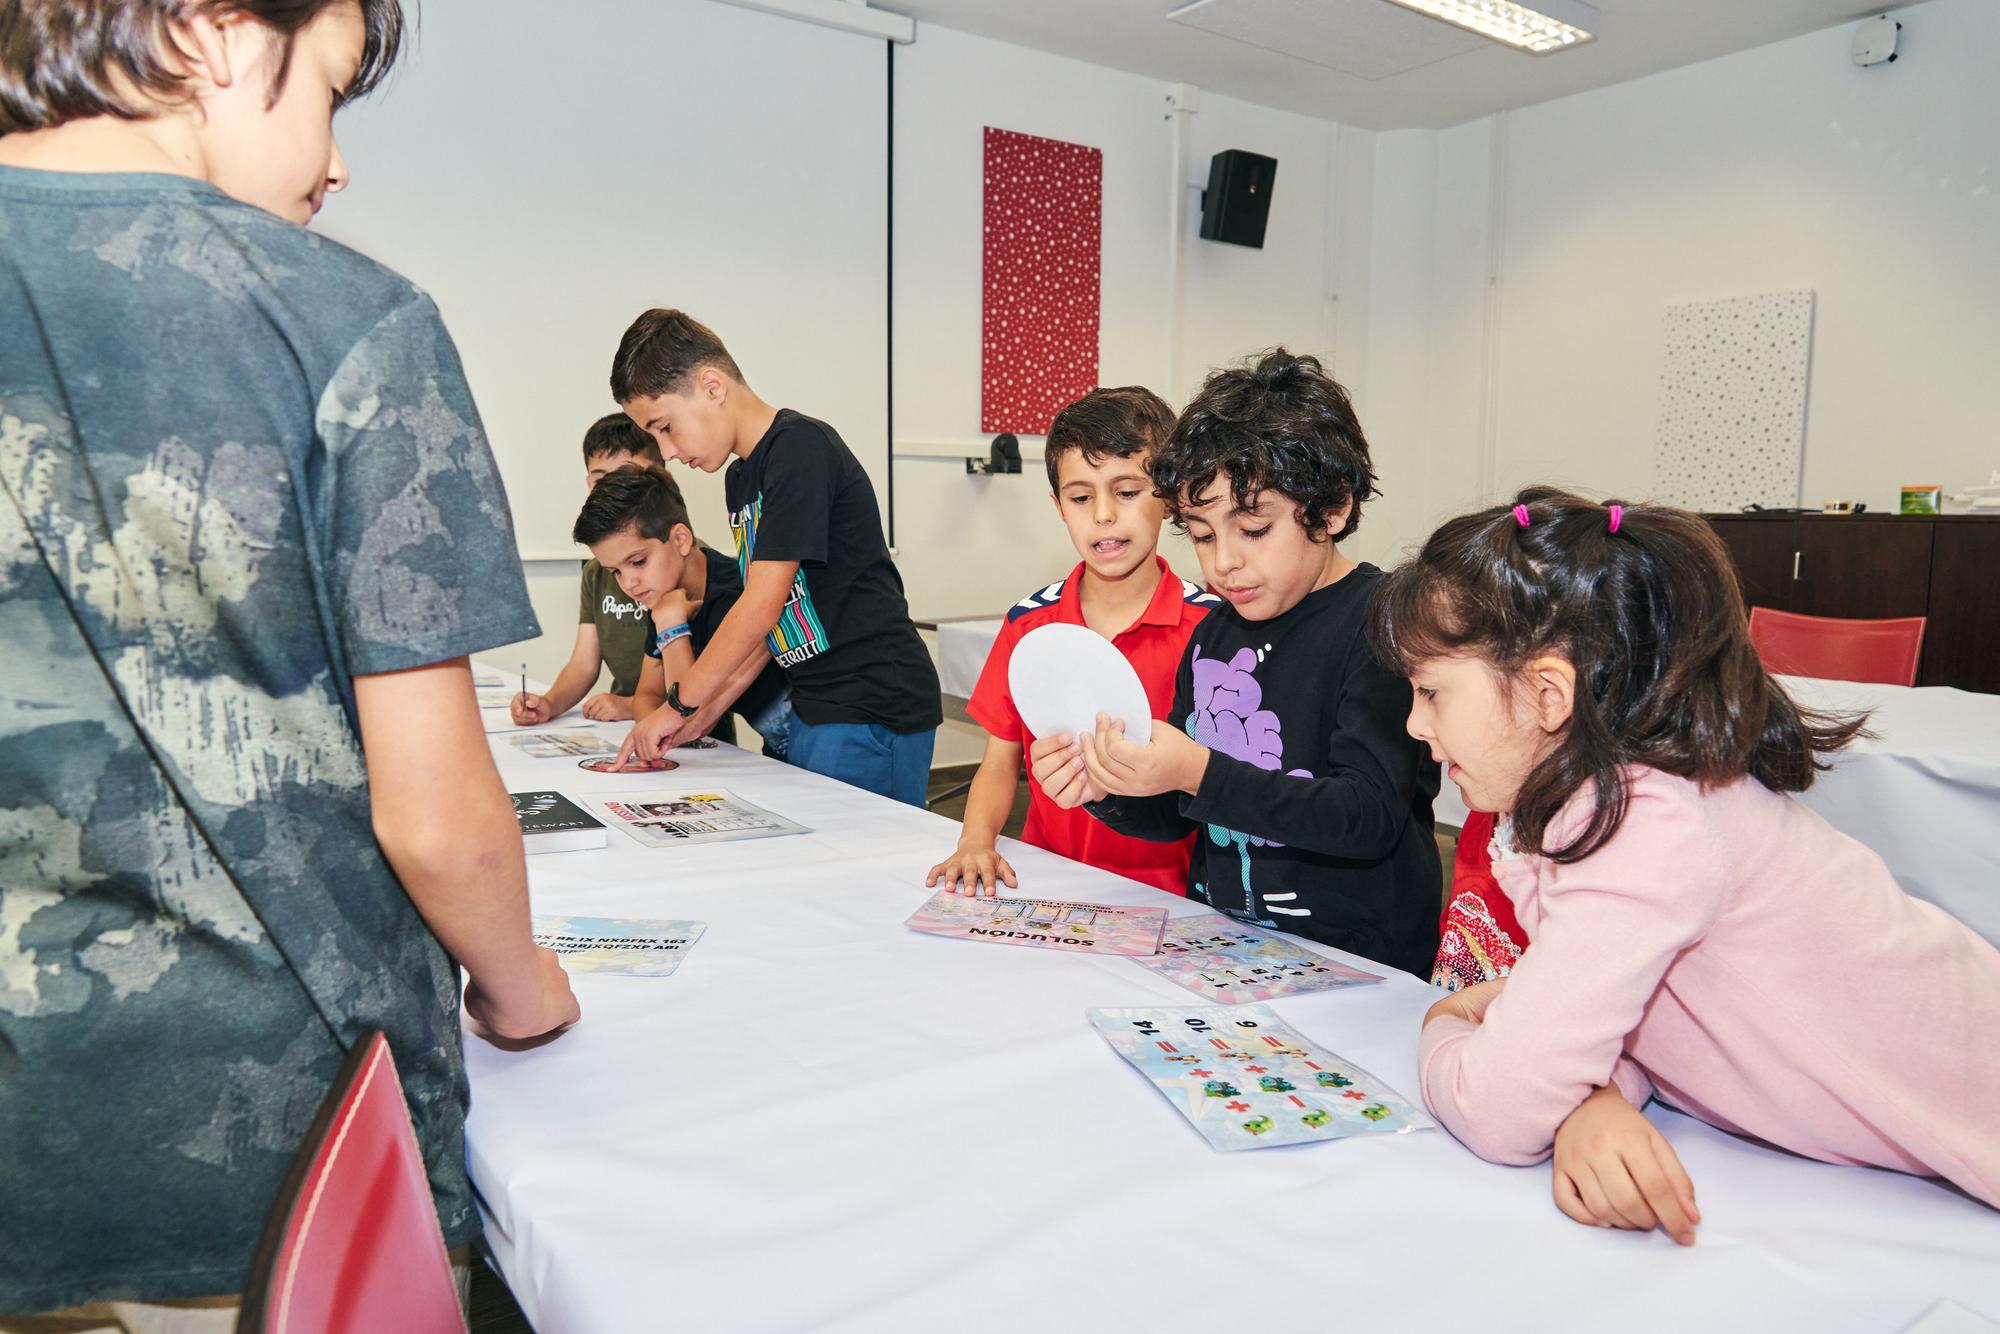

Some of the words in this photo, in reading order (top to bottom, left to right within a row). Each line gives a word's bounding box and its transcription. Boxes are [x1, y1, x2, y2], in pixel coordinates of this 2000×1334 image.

[602, 595, 635, 620] Pepe
[523, 821, 584, 829] TEWART
[968, 927, 1095, 946] SOLUCIÓN
[1132, 1020, 1161, 1036] 14
[1184, 1018, 1212, 1033] 10
